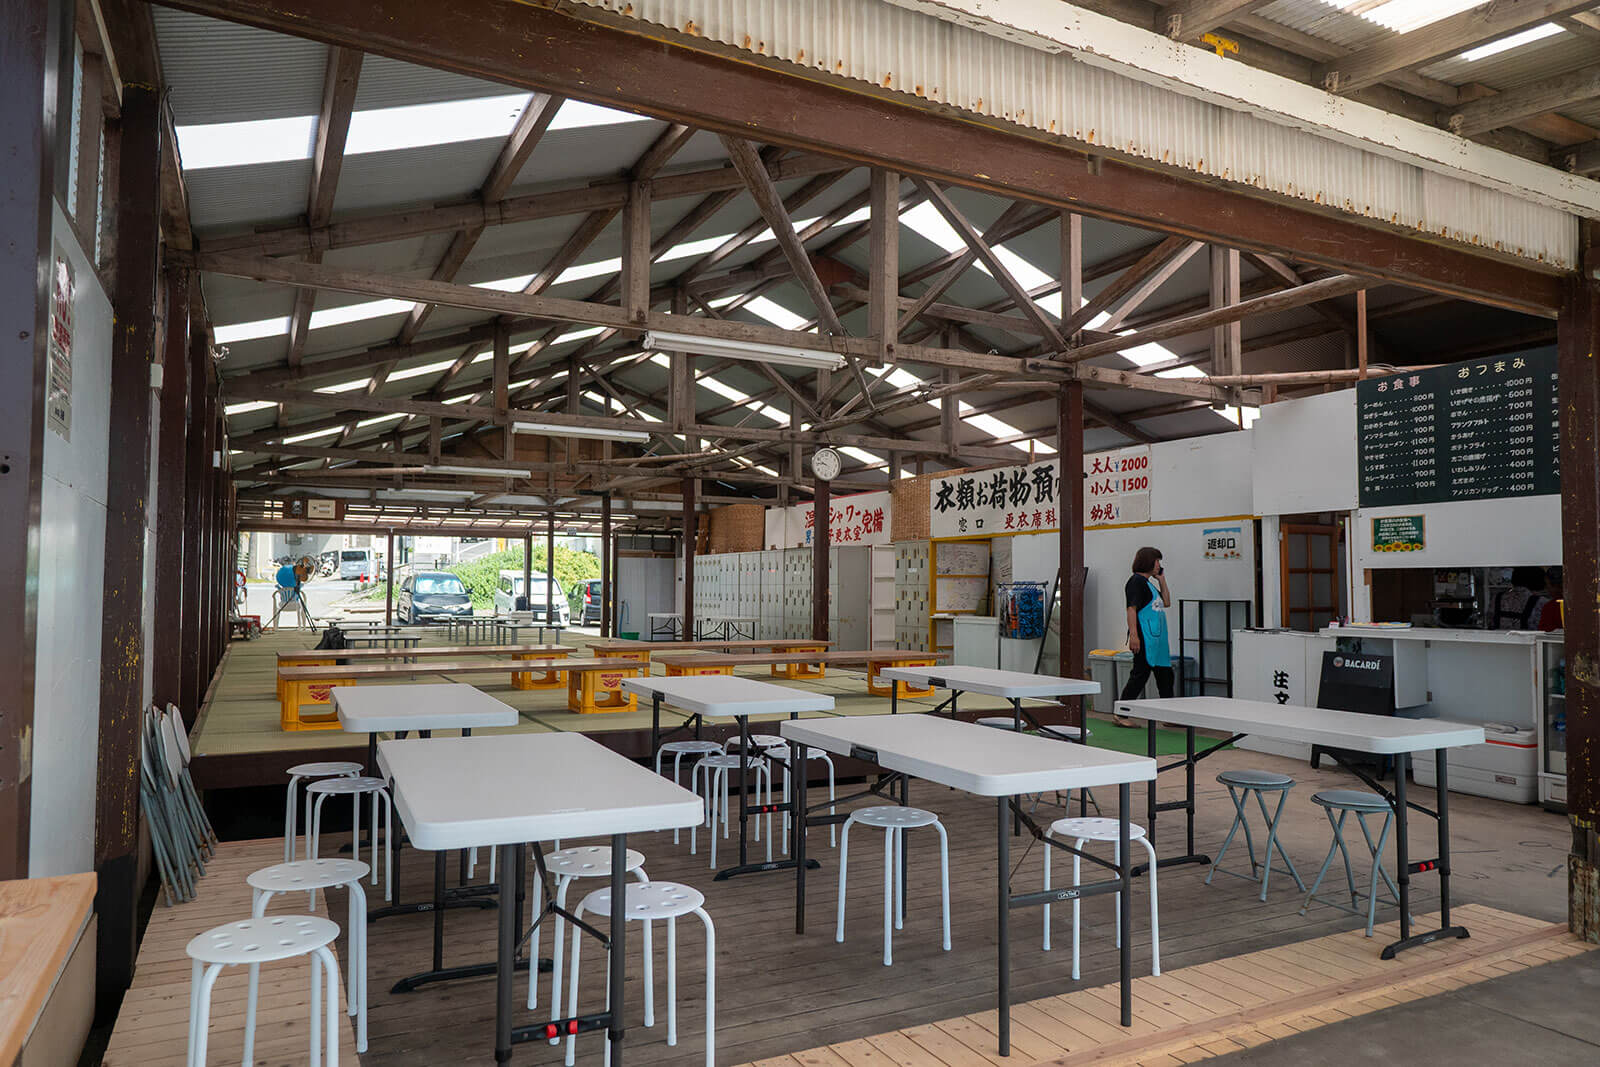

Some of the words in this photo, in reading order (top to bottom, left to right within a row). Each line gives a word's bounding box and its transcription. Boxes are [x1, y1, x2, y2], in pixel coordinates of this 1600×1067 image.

[1457, 357, 1526, 379] おつまみ
[1377, 375, 1420, 392] お食事
[1090, 456, 1114, 474] 大人
[1090, 478, 1114, 496] 小人
[1090, 503, 1114, 522] 幼児
[958, 517, 985, 533] 窓口
[1207, 537, 1236, 550] 返却口
[1344, 658, 1381, 671] BACARDÍ
[1273, 669, 1290, 705] 注文
